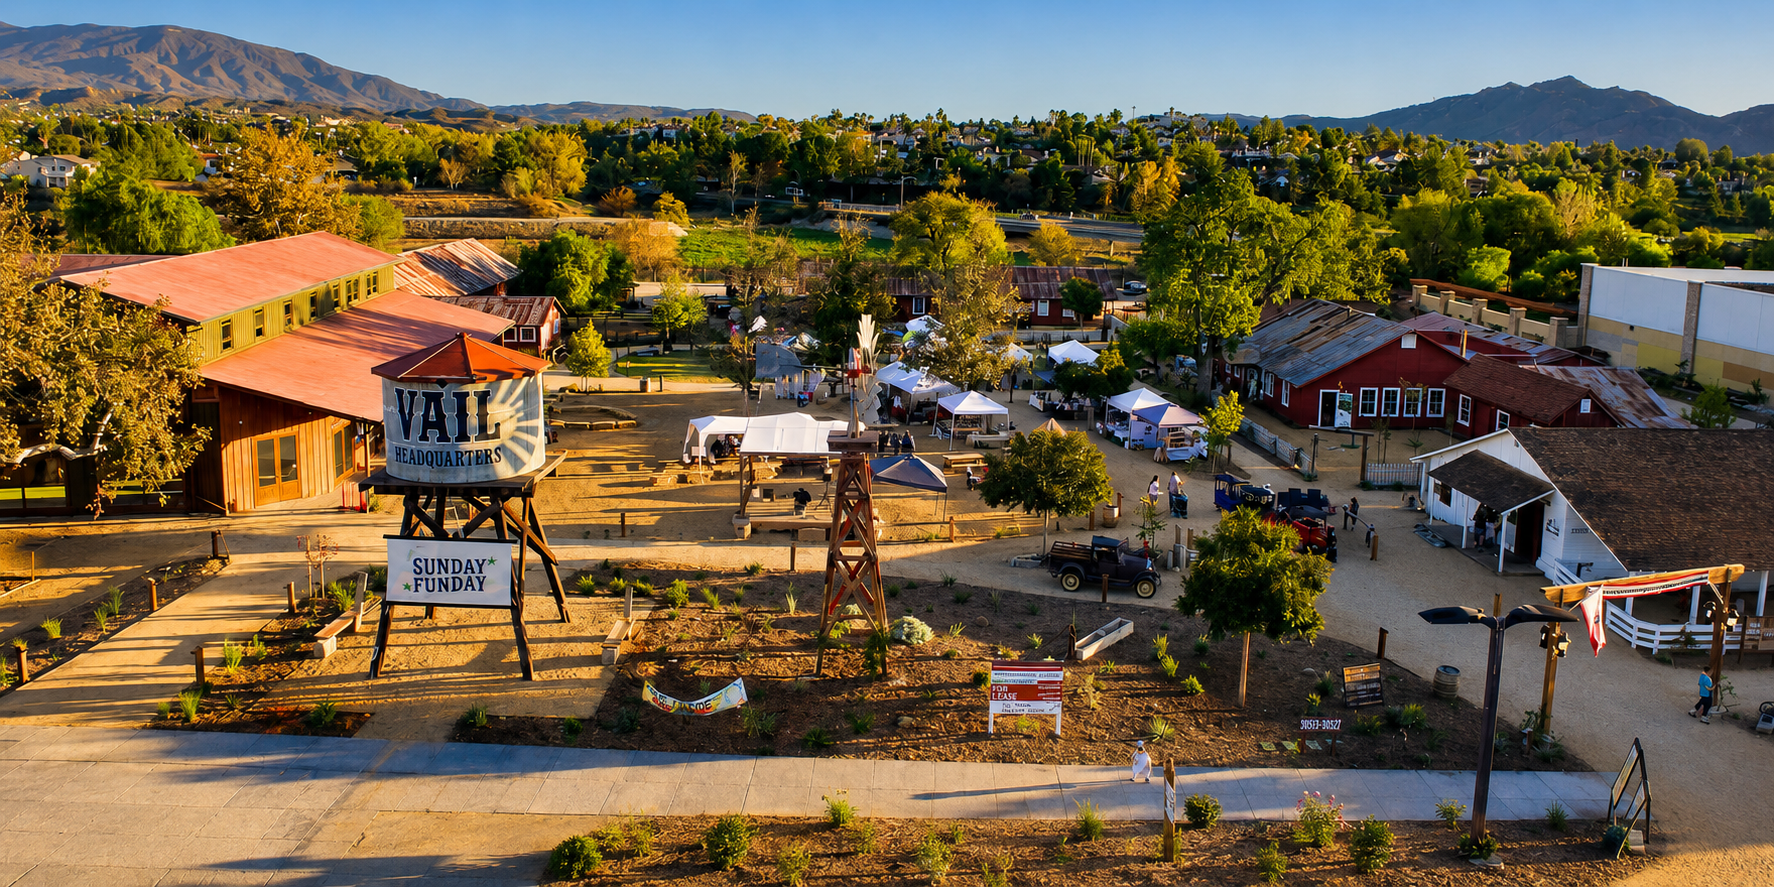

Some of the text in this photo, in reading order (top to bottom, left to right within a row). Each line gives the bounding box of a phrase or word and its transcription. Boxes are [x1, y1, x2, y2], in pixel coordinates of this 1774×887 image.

[394, 387, 502, 444] VAIL
[394, 446, 502, 469] HEADQUARTERS
[412, 557, 487, 575] SUNDAY
[413, 575, 487, 593] FUNDAY
[992, 692, 1017, 700] LEASE
